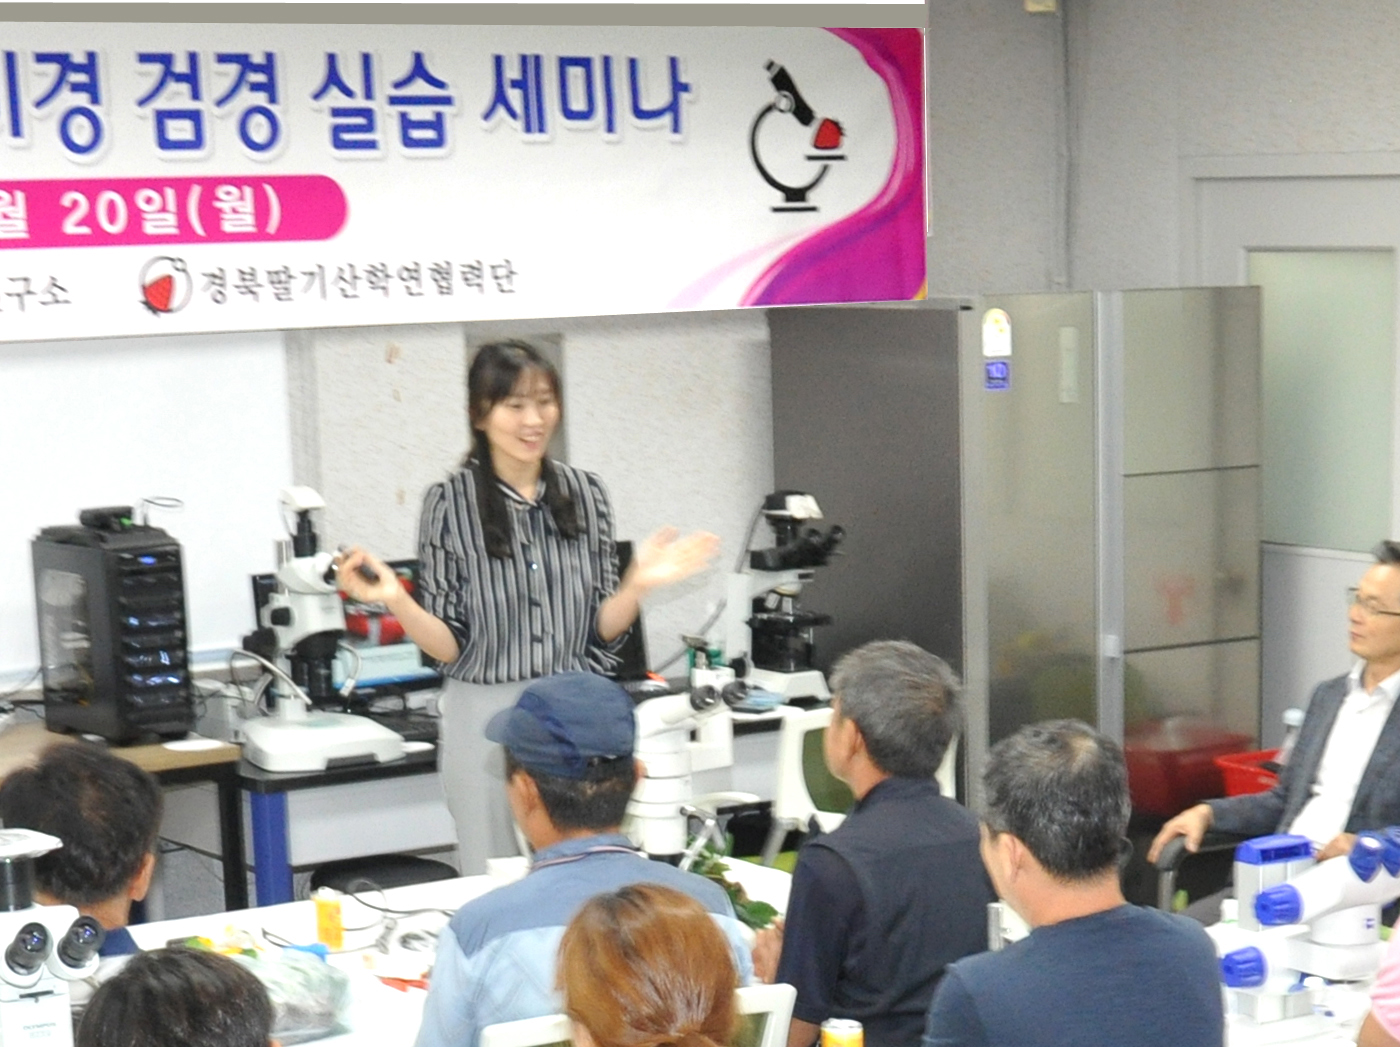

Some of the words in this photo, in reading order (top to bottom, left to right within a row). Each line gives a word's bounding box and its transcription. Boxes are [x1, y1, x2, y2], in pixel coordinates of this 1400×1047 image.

[136, 50, 281, 152] 검경
[311, 52, 454, 150] 실습
[481, 54, 691, 134] 세미나
[59, 182, 281, 237] 20일(월)
[199, 258, 518, 306] 경북딸기산학연협력단
